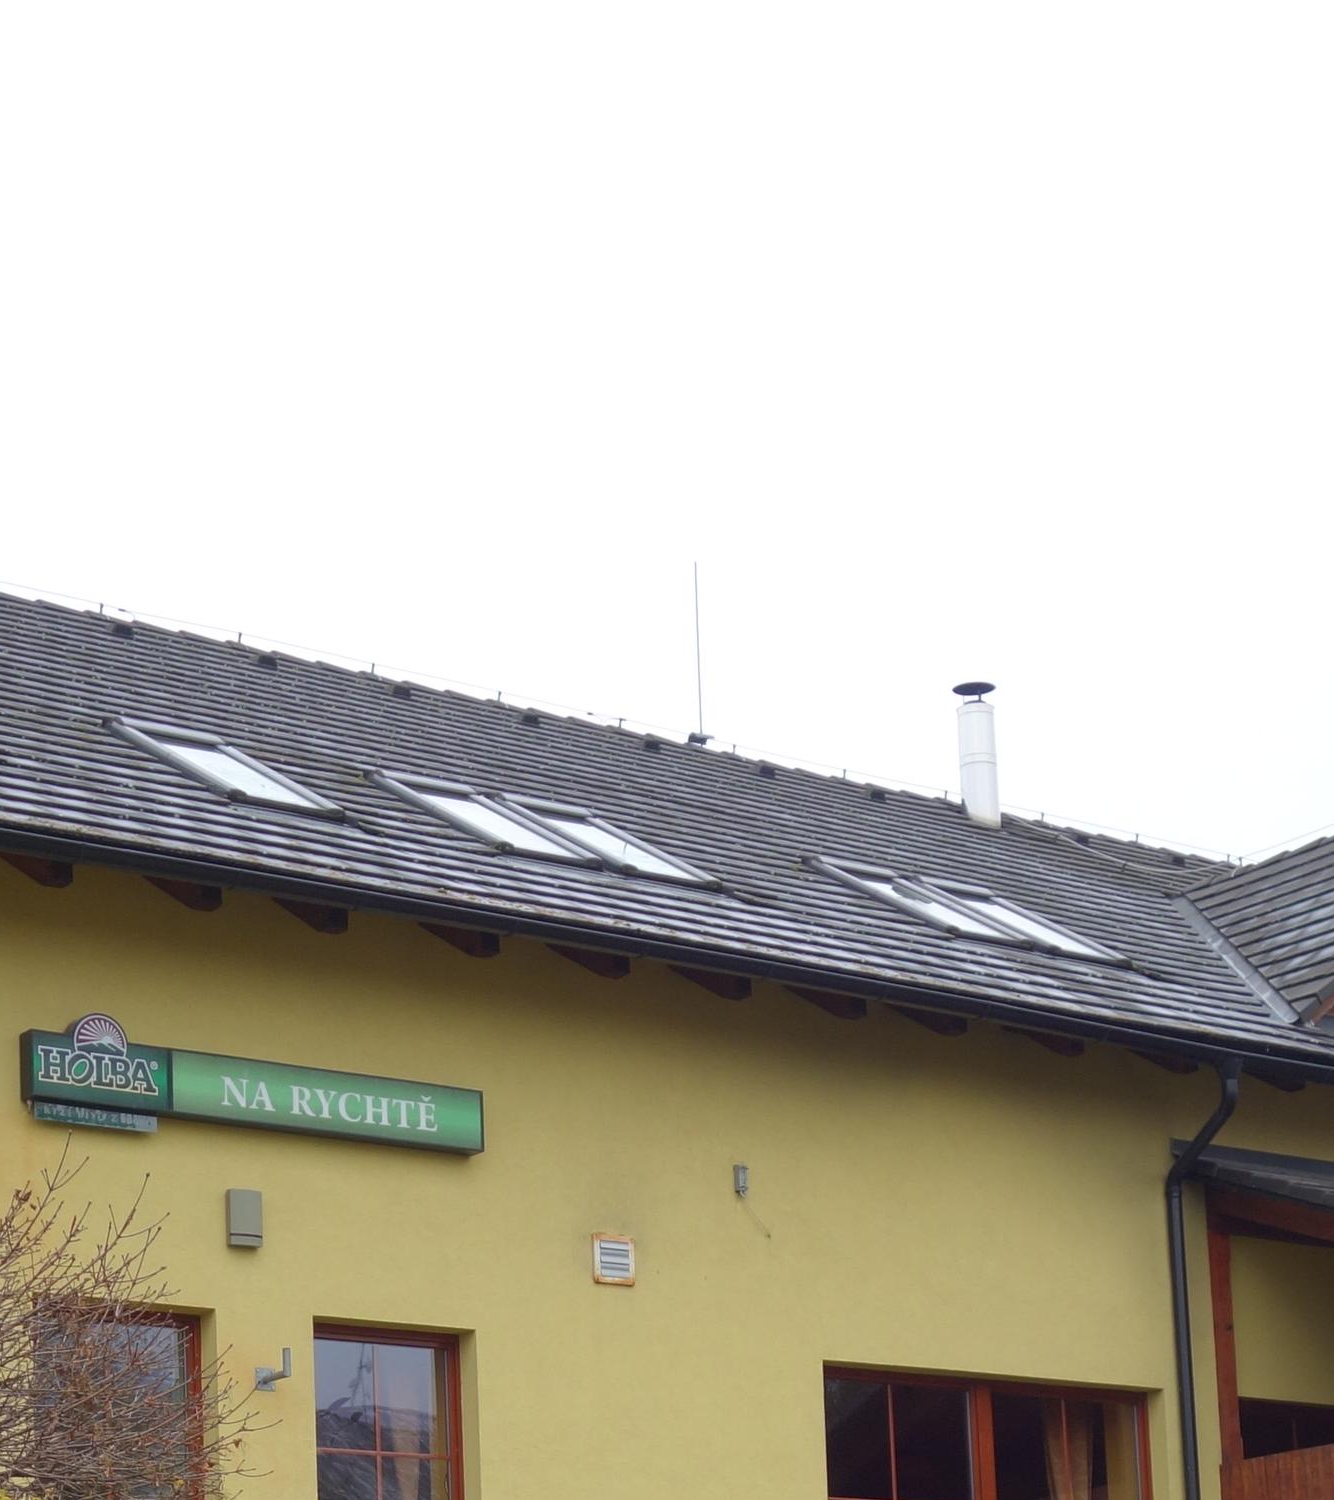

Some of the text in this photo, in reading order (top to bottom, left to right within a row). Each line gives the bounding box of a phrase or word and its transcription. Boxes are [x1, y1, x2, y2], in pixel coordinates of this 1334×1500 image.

[38, 1045, 158, 1096] HOLBA
[221, 1075, 438, 1132] NA RYCHTĚ
